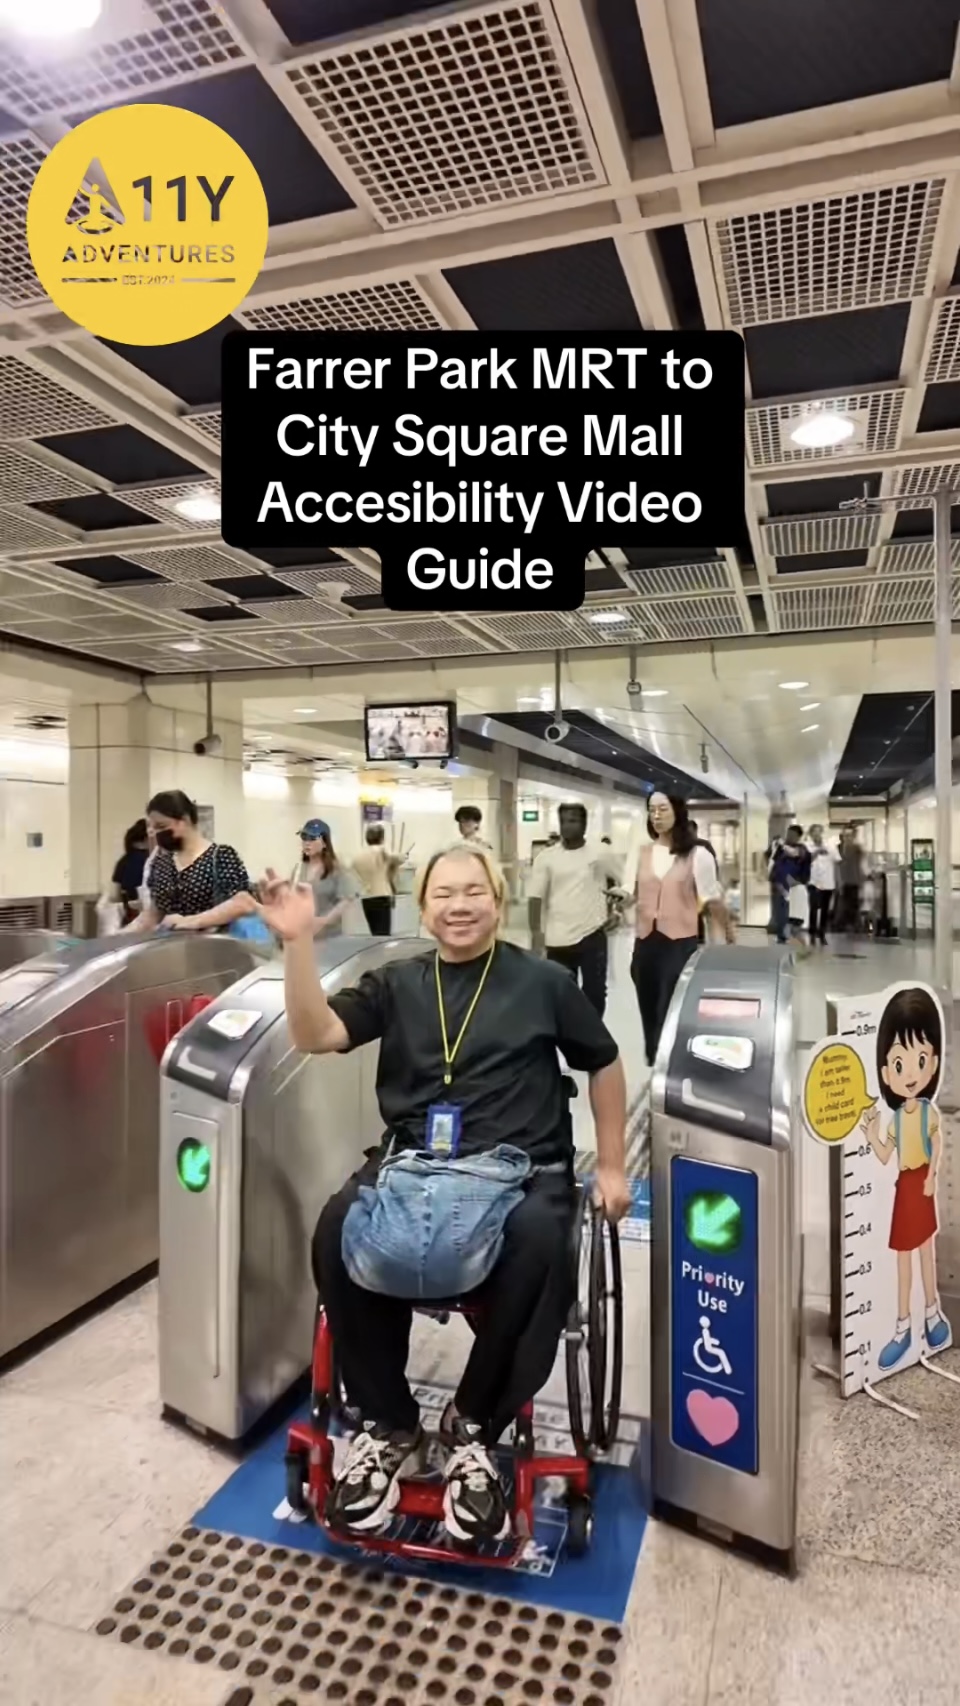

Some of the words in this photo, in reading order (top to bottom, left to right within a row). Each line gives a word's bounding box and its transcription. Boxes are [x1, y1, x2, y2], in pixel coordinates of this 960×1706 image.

[856, 1024, 877, 1037] 0.9m
[858, 1183, 872, 1196] 0.5
[858, 1223, 872, 1236] 0.4
[858, 1261, 872, 1275] 0.3
[698, 1289, 727, 1313] Use
[858, 1301, 872, 1315] 0.2
[858, 1341, 872, 1356] 0.1
